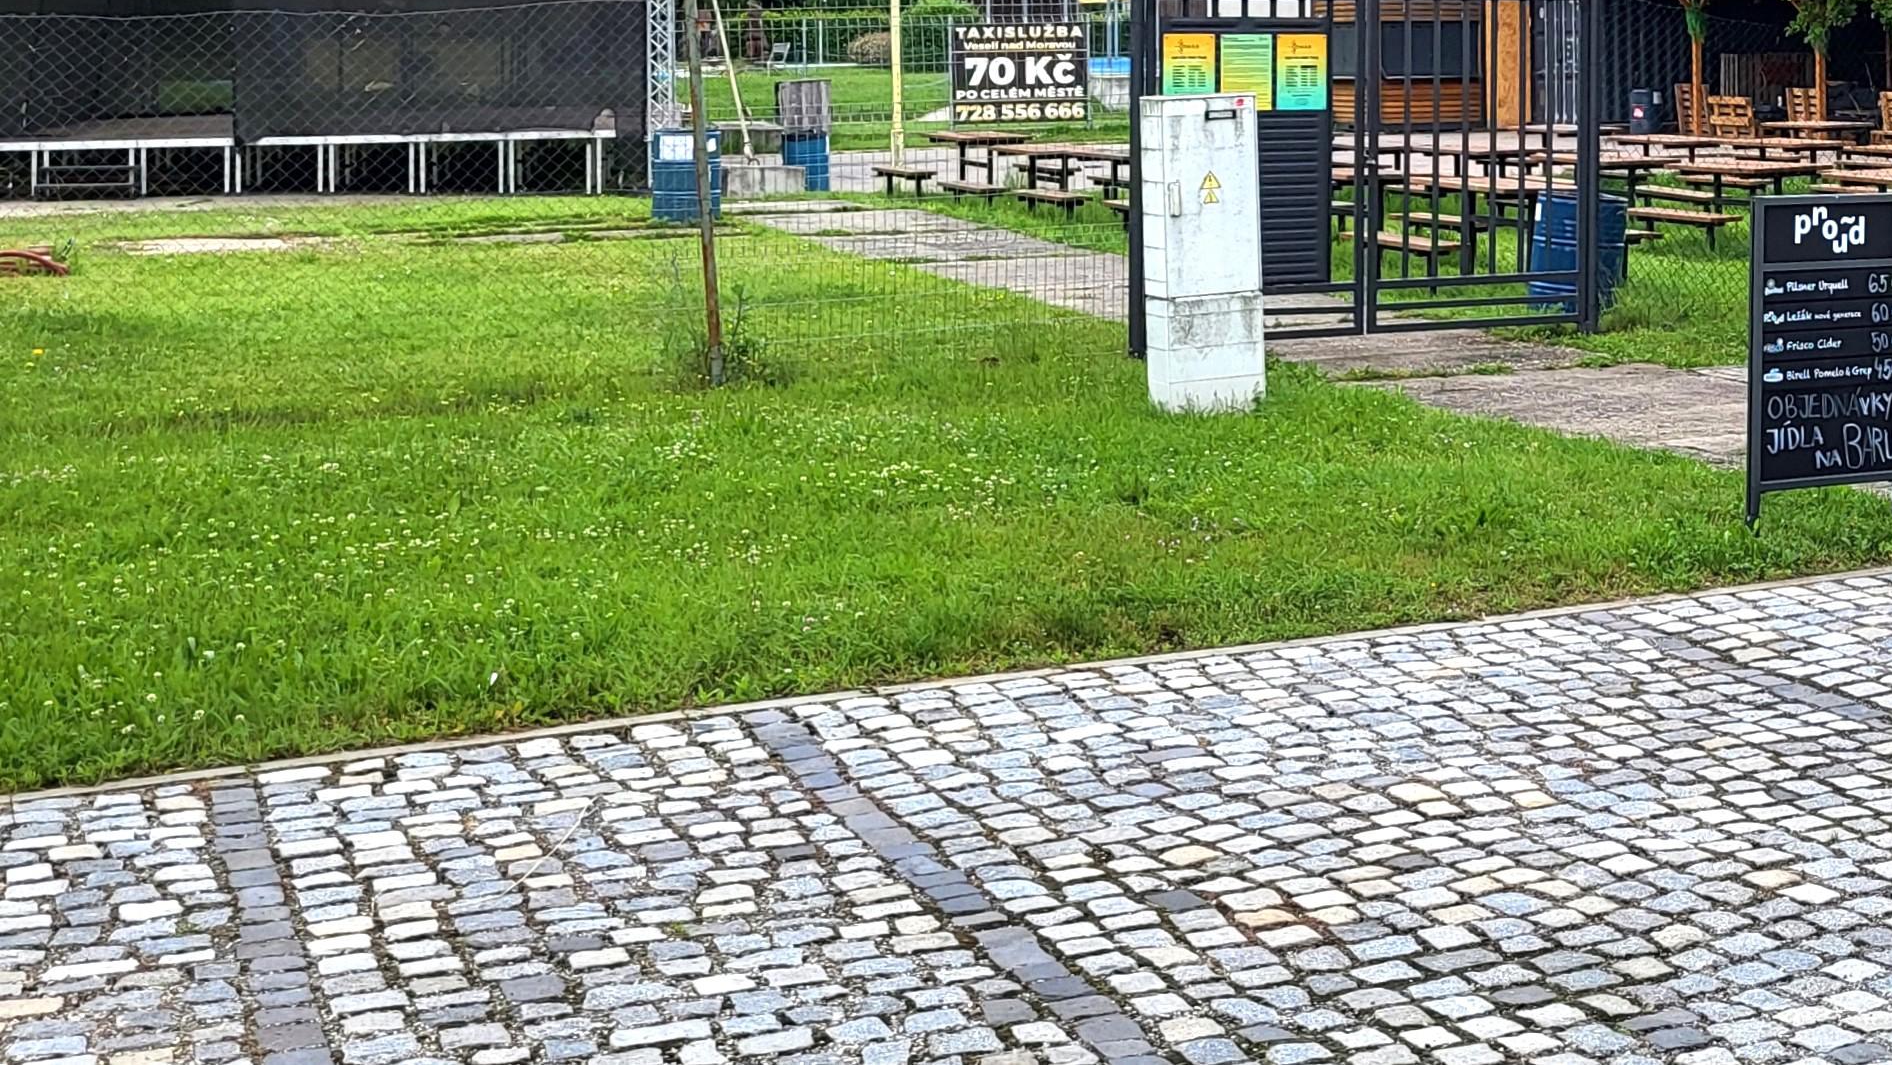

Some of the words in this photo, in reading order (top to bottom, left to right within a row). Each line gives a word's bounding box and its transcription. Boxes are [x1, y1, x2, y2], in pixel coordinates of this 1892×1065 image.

[955, 24, 1083, 39] TAXISLUŽBA
[963, 41, 999, 50] Veselí
[1001, 41, 1024, 49] nad
[1026, 41, 1076, 49] Moravou
[964, 56, 1016, 86] 70
[1025, 53, 1076, 85] Kč
[956, 90, 978, 100] PO
[980, 87, 1031, 99] CELÉM
[1034, 86, 1085, 98] MĚSTĚ
[955, 104, 996, 121] 728
[1001, 103, 1041, 120] 556
[1044, 102, 1085, 119] 666
[1794, 206, 1865, 254] proud
[1786, 280, 1816, 292] Pilsner
[1818, 279, 1849, 294] Urquell
[1868, 273, 1889, 293] 65
[1786, 308, 1813, 322] Ležák
[1871, 302, 1889, 323] 60
[1786, 341, 1814, 351] Frisco
[1817, 337, 1842, 349] Cider
[1871, 332, 1889, 353] 50
[1786, 369, 1811, 380] Birell
[1814, 368, 1844, 378] Pomelo
[1845, 366, 1850, 376] &
[1851, 366, 1872, 384] Grep
[1874, 356, 1892, 381] 45
[1766, 420, 1824, 455] JÍDLA
[1815, 449, 1842, 469] NA
